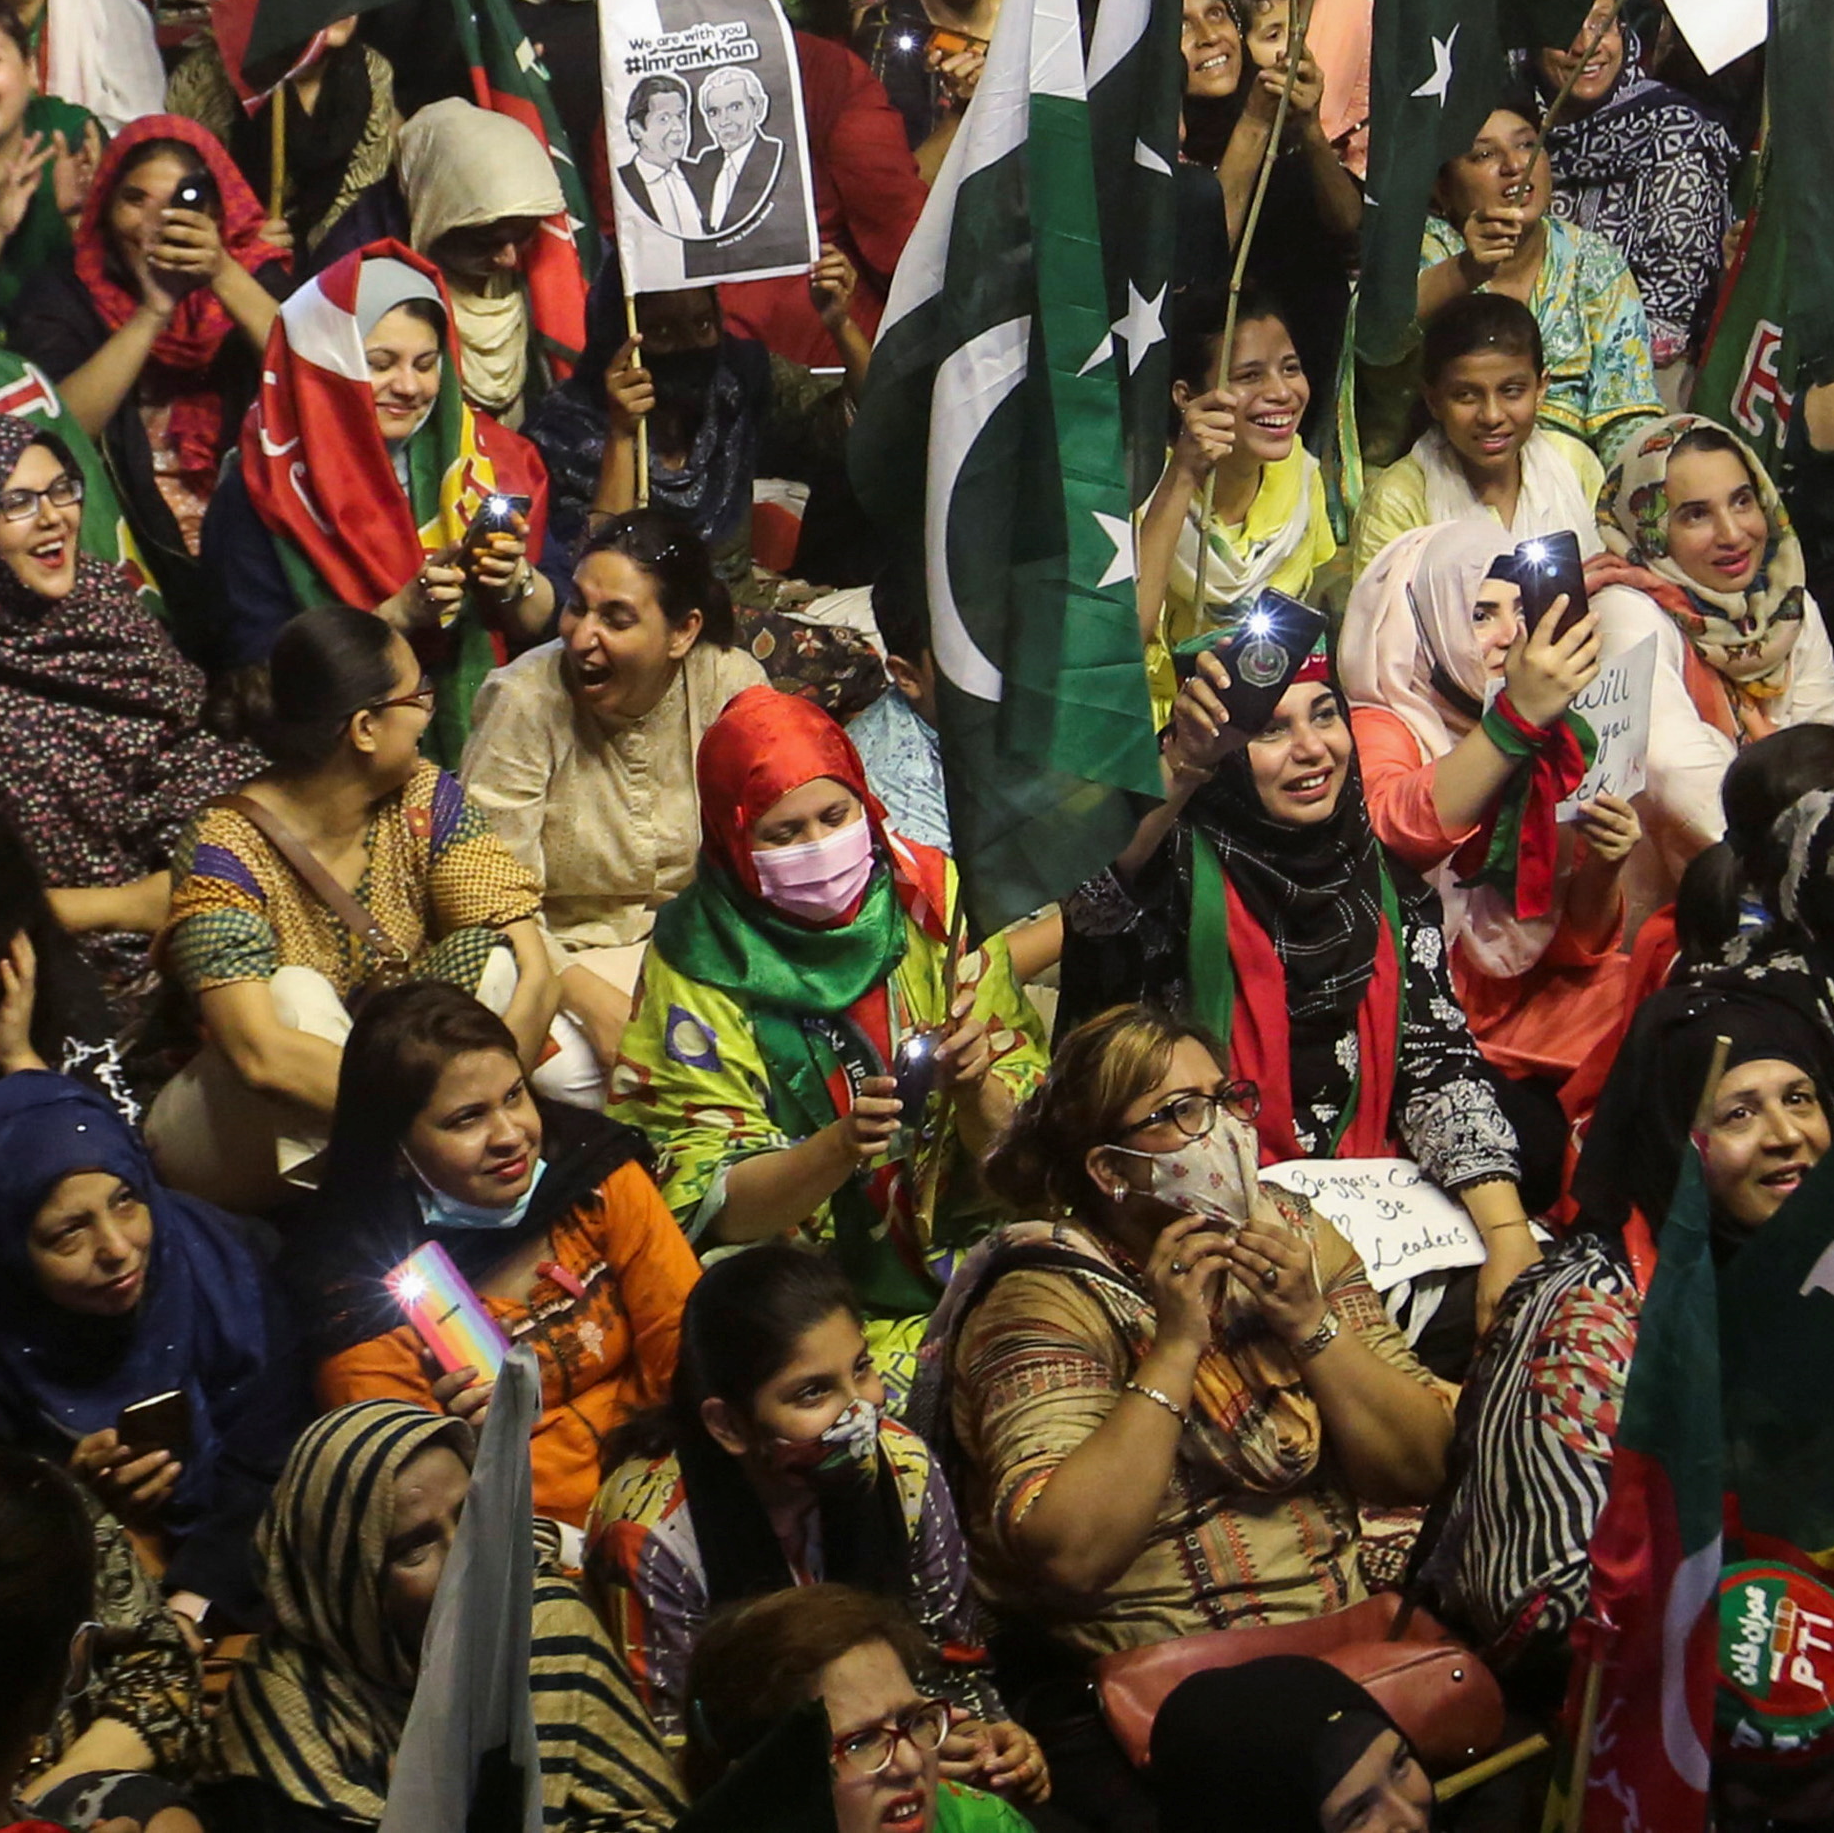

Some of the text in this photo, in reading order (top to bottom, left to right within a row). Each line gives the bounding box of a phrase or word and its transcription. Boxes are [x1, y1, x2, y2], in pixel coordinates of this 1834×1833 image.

[628, 24, 744, 51] We are with you
[624, 42, 755, 75] #ImranKhan
[1598, 715, 1631, 766] you
[1371, 1226, 1468, 1272] Leaders
